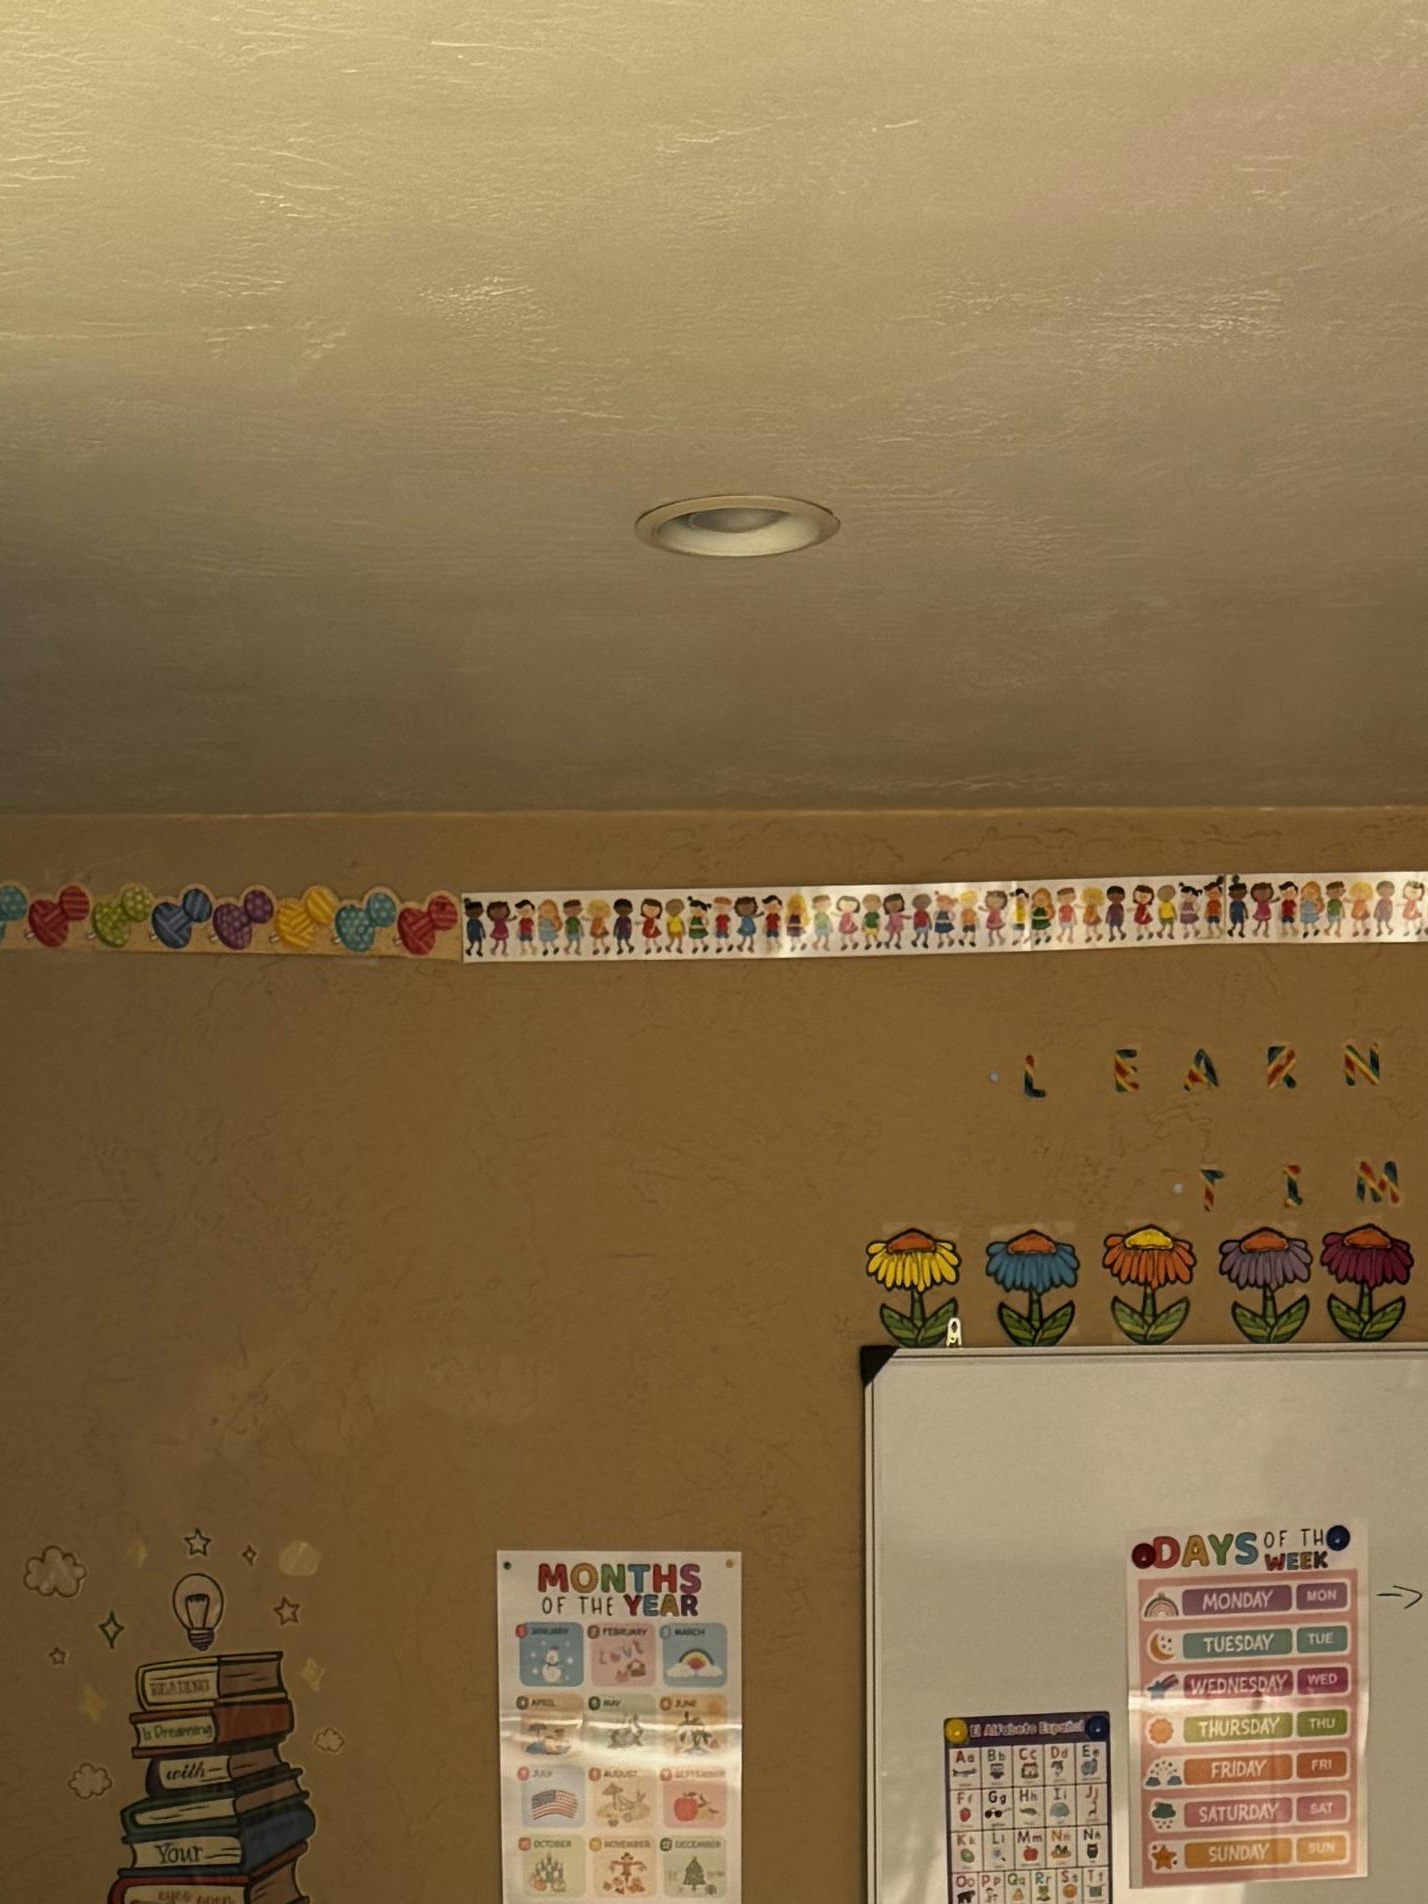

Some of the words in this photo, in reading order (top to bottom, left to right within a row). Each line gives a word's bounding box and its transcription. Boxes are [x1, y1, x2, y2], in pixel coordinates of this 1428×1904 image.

[1152, 1531, 1258, 1569] DAYS
[1264, 1531, 1288, 1549] OF
[1301, 1529, 1324, 1546] TH
[1264, 1551, 1328, 1571] WEEK
[538, 1562, 702, 1593] MONTHS
[541, 1597, 564, 1615] OF
[580, 1596, 614, 1616] THE
[623, 1593, 698, 1617] YEAR
[1202, 1590, 1273, 1611] MONDAY
[1307, 1589, 1337, 1602] MON
[602, 1627, 647, 1638] FEBRUARY
[1204, 1633, 1274, 1652] TUESDAY
[1308, 1632, 1334, 1645] TUE
[1191, 1673, 1288, 1695] WEDNESDAY
[1307, 1672, 1337, 1686] WED
[1197, 1717, 1280, 1737] THURSDAY
[1309, 1717, 1336, 1730] THU
[165, 1762, 206, 1780] with
[1211, 1759, 1267, 1778] FRIDAY
[1311, 1759, 1332, 1771] FRI
[1199, 1802, 1279, 1824] SATURDAY
[1310, 1802, 1334, 1815] SAT
[155, 1844, 204, 1864] Your
[533, 1839, 572, 1849] OCTOBER
[1208, 1843, 1270, 1863] SUNDAY
[1308, 1842, 1336, 1854] SUN
